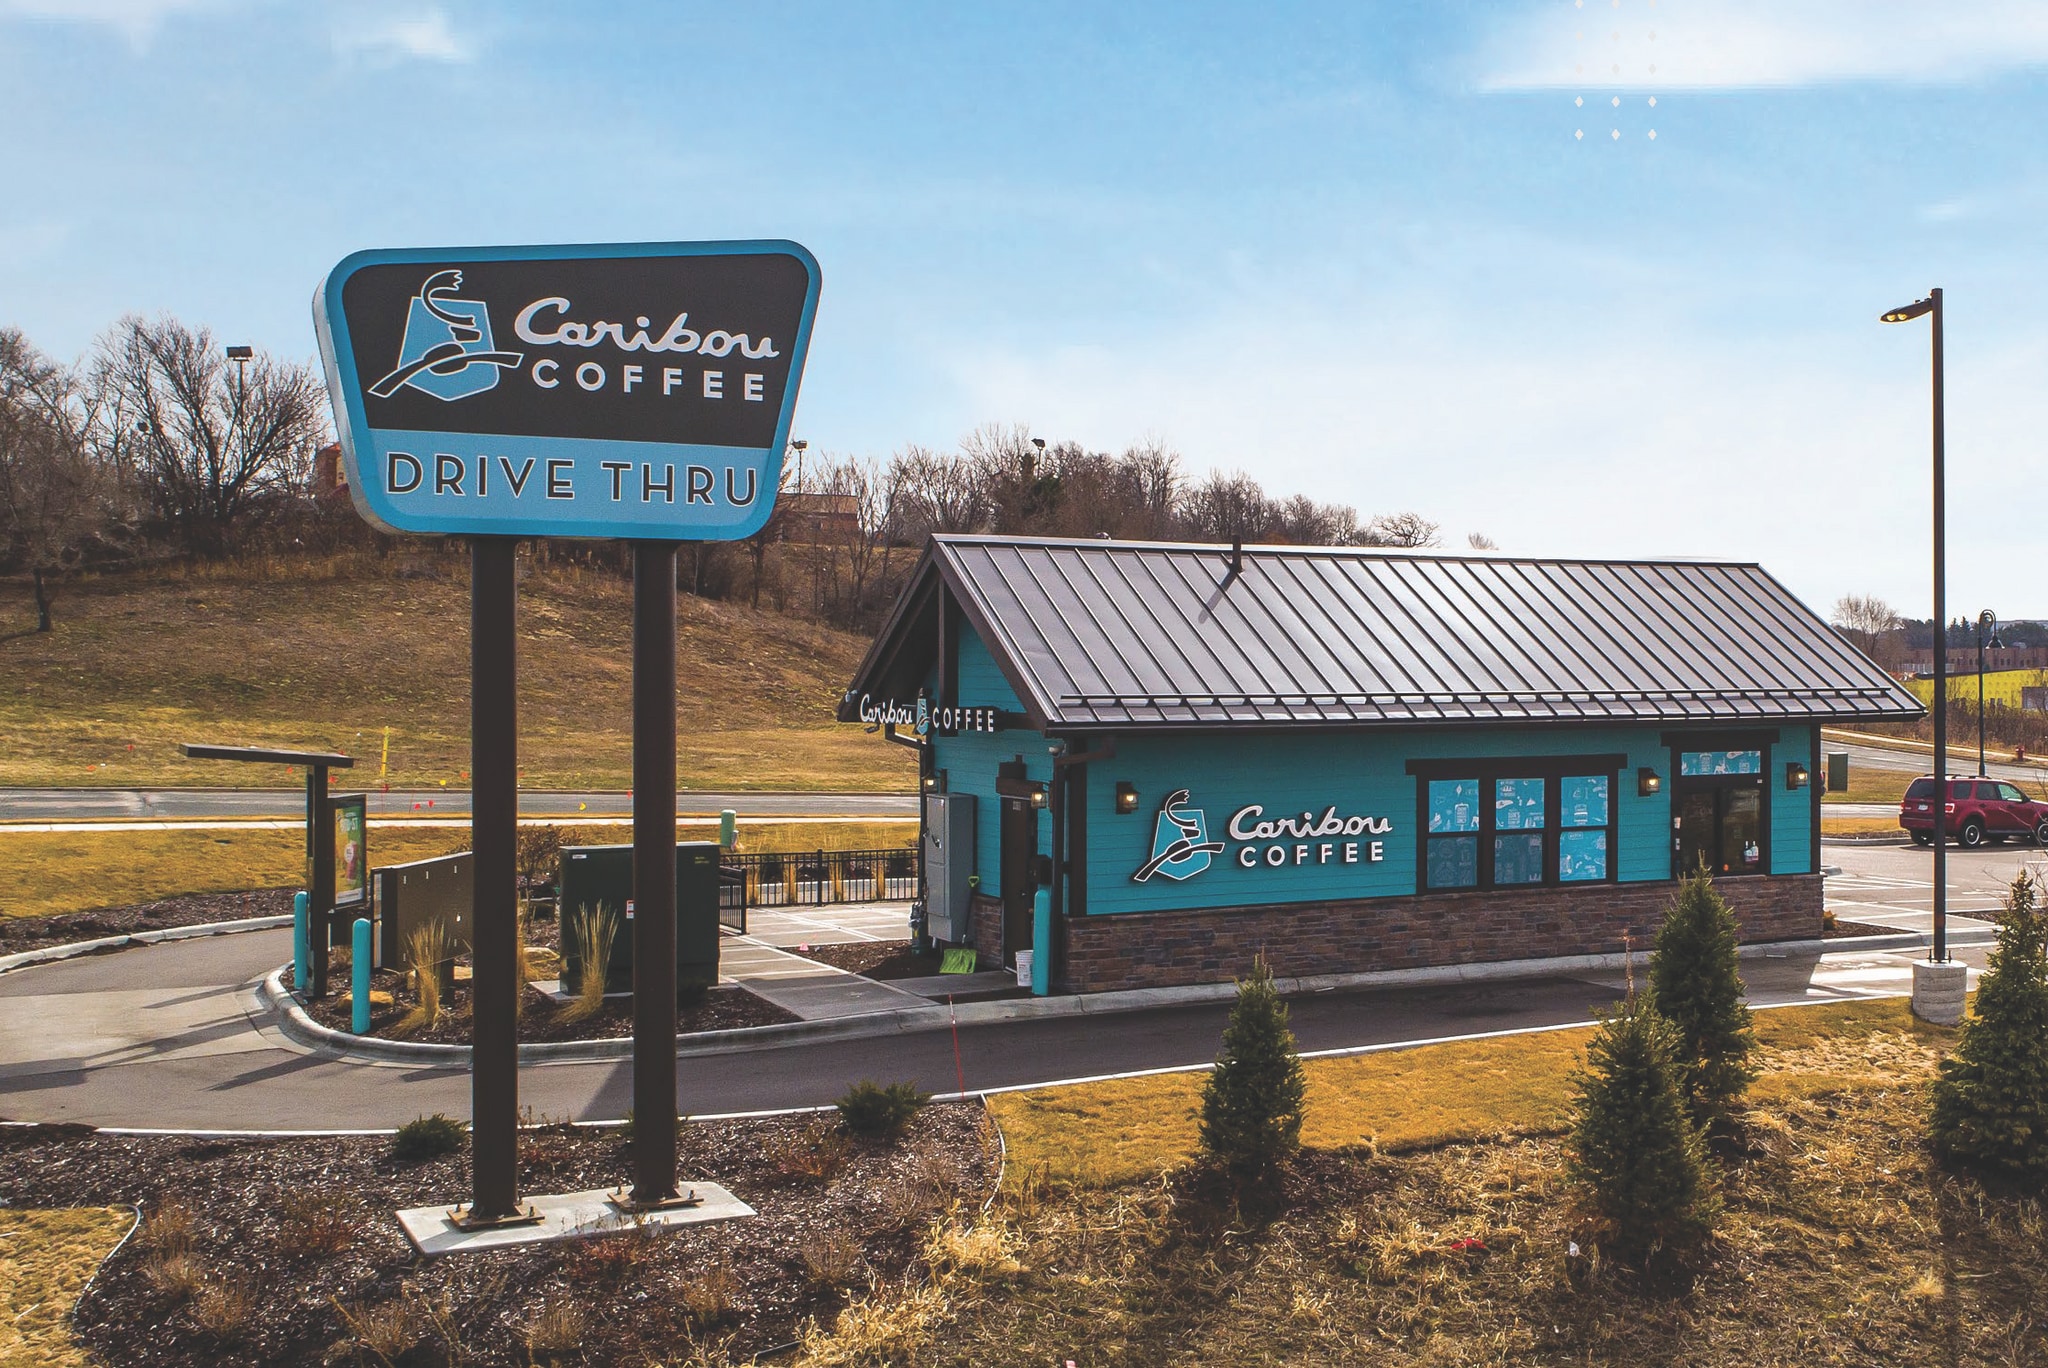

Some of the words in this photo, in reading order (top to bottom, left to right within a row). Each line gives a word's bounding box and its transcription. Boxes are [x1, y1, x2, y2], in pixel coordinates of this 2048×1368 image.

[514, 297, 780, 359] Caribou
[531, 359, 764, 402] COFFEE
[386, 451, 576, 500] DRIVE
[602, 461, 757, 506] THRU
[859, 693, 913, 725] Caribou
[932, 707, 994, 733] COFFEE
[1229, 805, 1393, 841] Caribou
[1239, 841, 1384, 868] COFFEE
